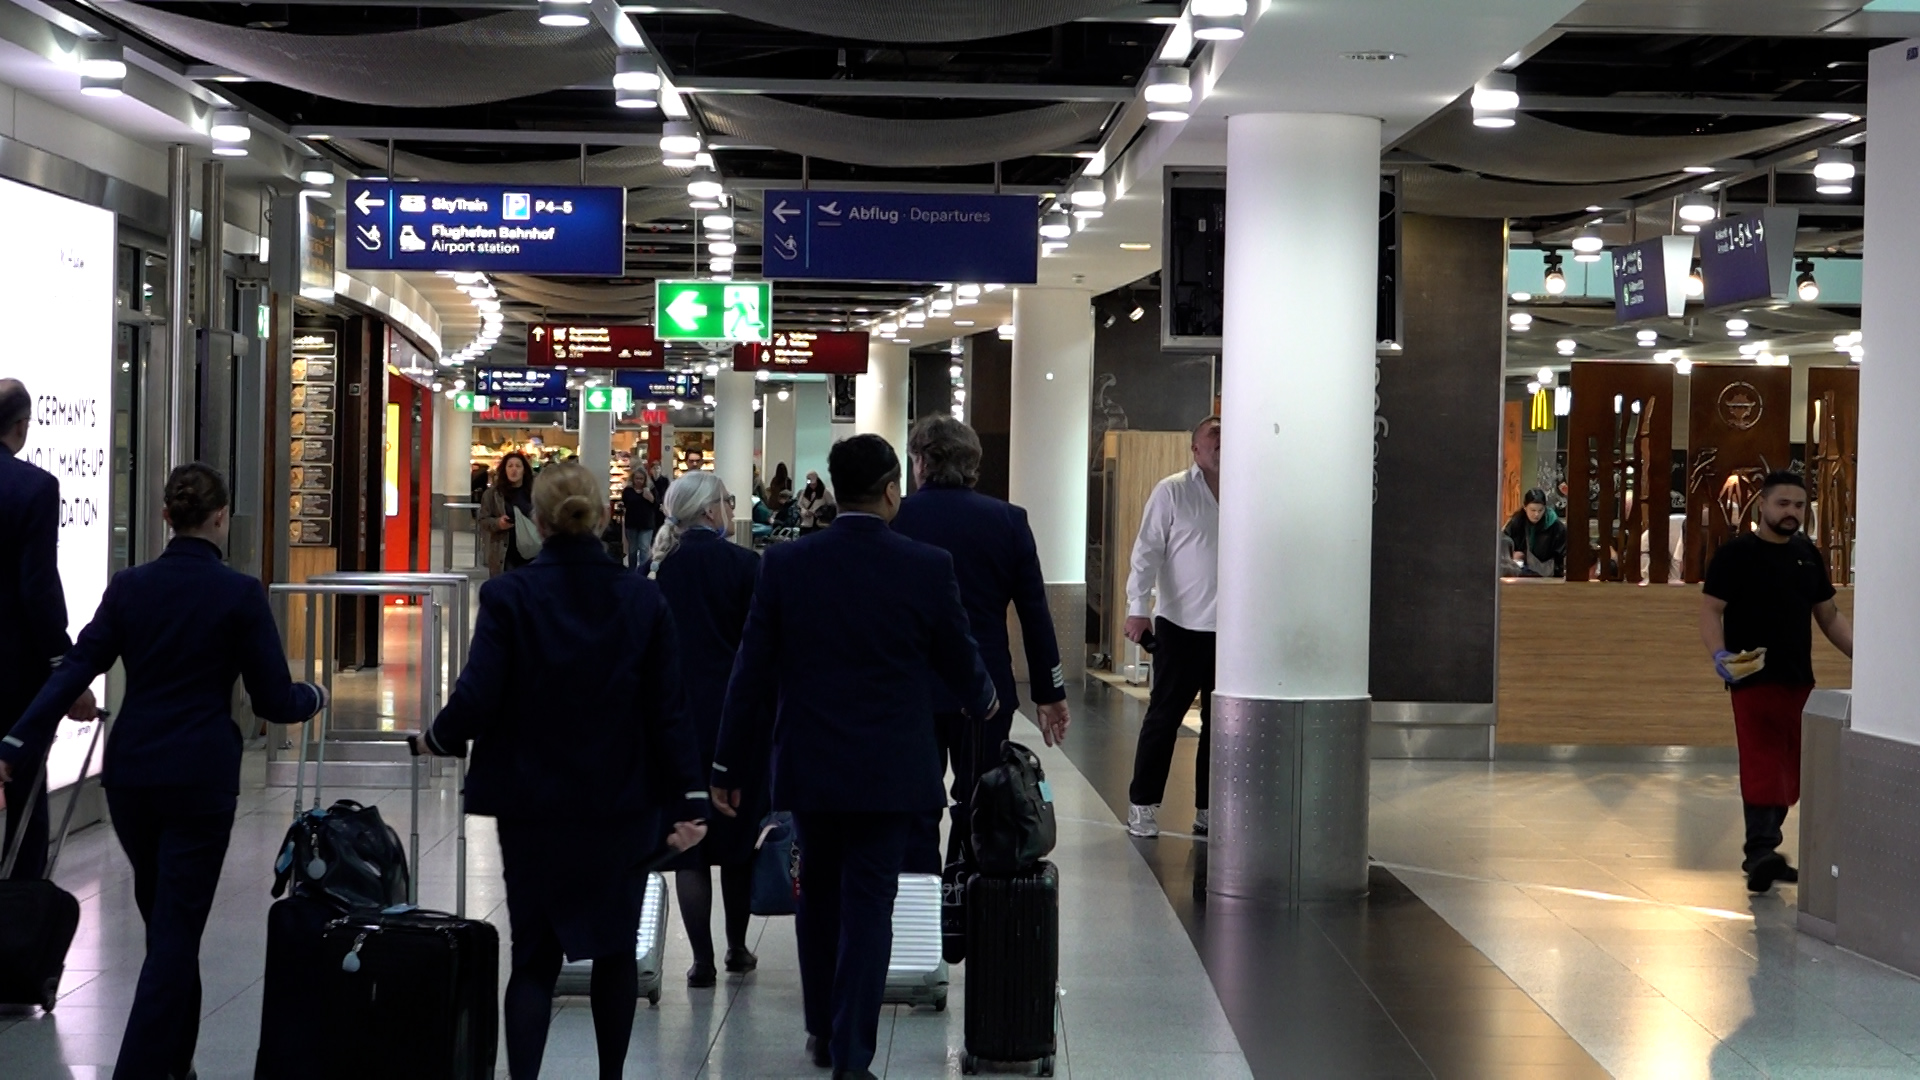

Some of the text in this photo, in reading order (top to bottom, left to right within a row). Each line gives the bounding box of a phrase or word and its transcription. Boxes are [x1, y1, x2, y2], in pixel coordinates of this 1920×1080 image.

[432, 197, 488, 214] SkyTrain
[848, 206, 991, 224] Abflug Departures
[431, 224, 555, 240] Flughafen Bahnhof
[431, 239, 520, 255] Airport station
[37, 395, 96, 427] GERMANY'S
[59, 447, 104, 477] MAKE-UP
[60, 498, 98, 527] DATION
